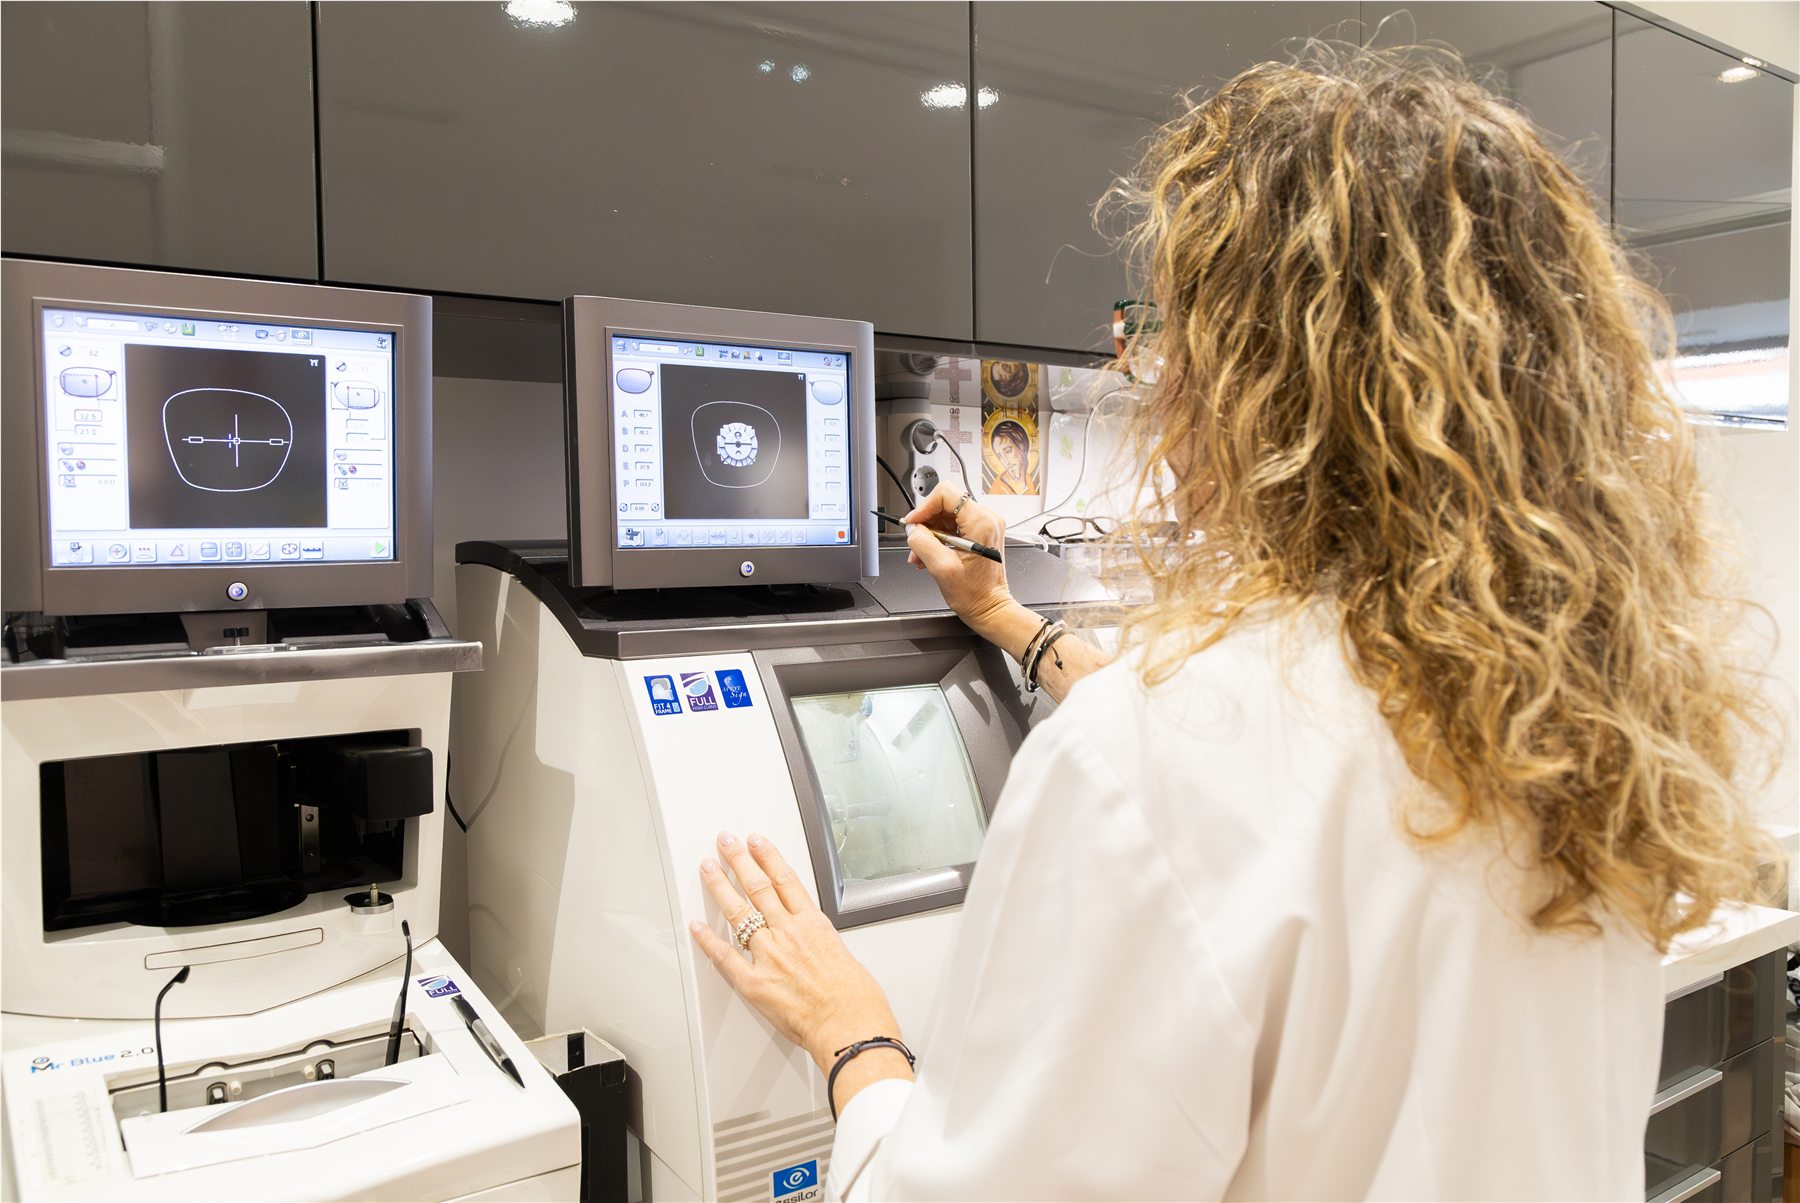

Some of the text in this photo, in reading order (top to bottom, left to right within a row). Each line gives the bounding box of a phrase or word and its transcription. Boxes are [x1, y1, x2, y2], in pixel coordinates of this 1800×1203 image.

[620, 409, 628, 418] A
[621, 427, 628, 435] B
[622, 444, 629, 453] D
[622, 462, 629, 470] E
[623, 479, 630, 488] P
[653, 702, 665, 710] FIT
[689, 696, 716, 707] FULL
[428, 986, 455, 996] FULL
[70, 1054, 116, 1067] Blue
[120, 1046, 154, 1058] 2.0
